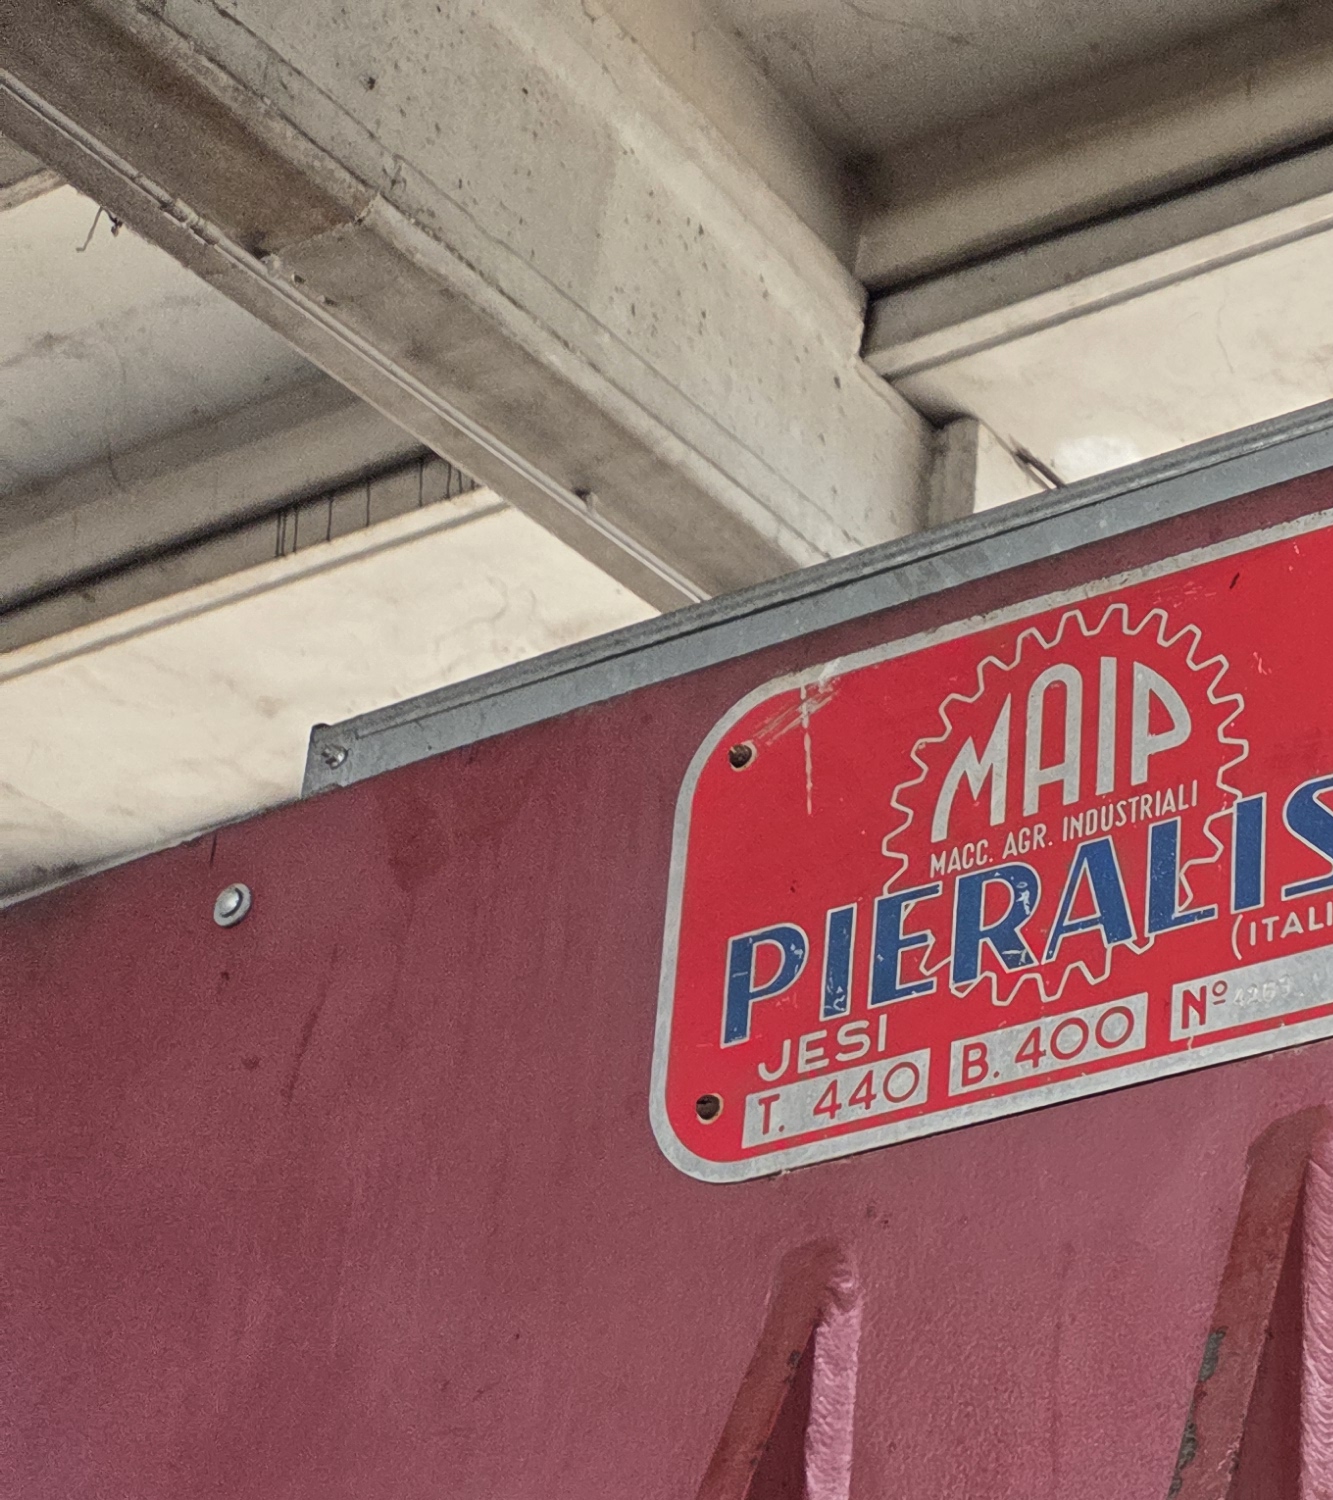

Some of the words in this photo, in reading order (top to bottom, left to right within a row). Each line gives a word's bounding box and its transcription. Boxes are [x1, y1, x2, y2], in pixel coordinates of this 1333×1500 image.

[931, 656, 1192, 844] MAIP
[930, 837, 995, 880] MACC.
[1002, 826, 1055, 860] AGR.
[1063, 780, 1198, 842] INDUSTRIALI
[757, 1014, 888, 1083] JESI
[958, 1040, 1001, 1084] B.
[1015, 1004, 1136, 1071] 400
[757, 1096, 787, 1136] T.
[811, 1060, 921, 1120] 440
